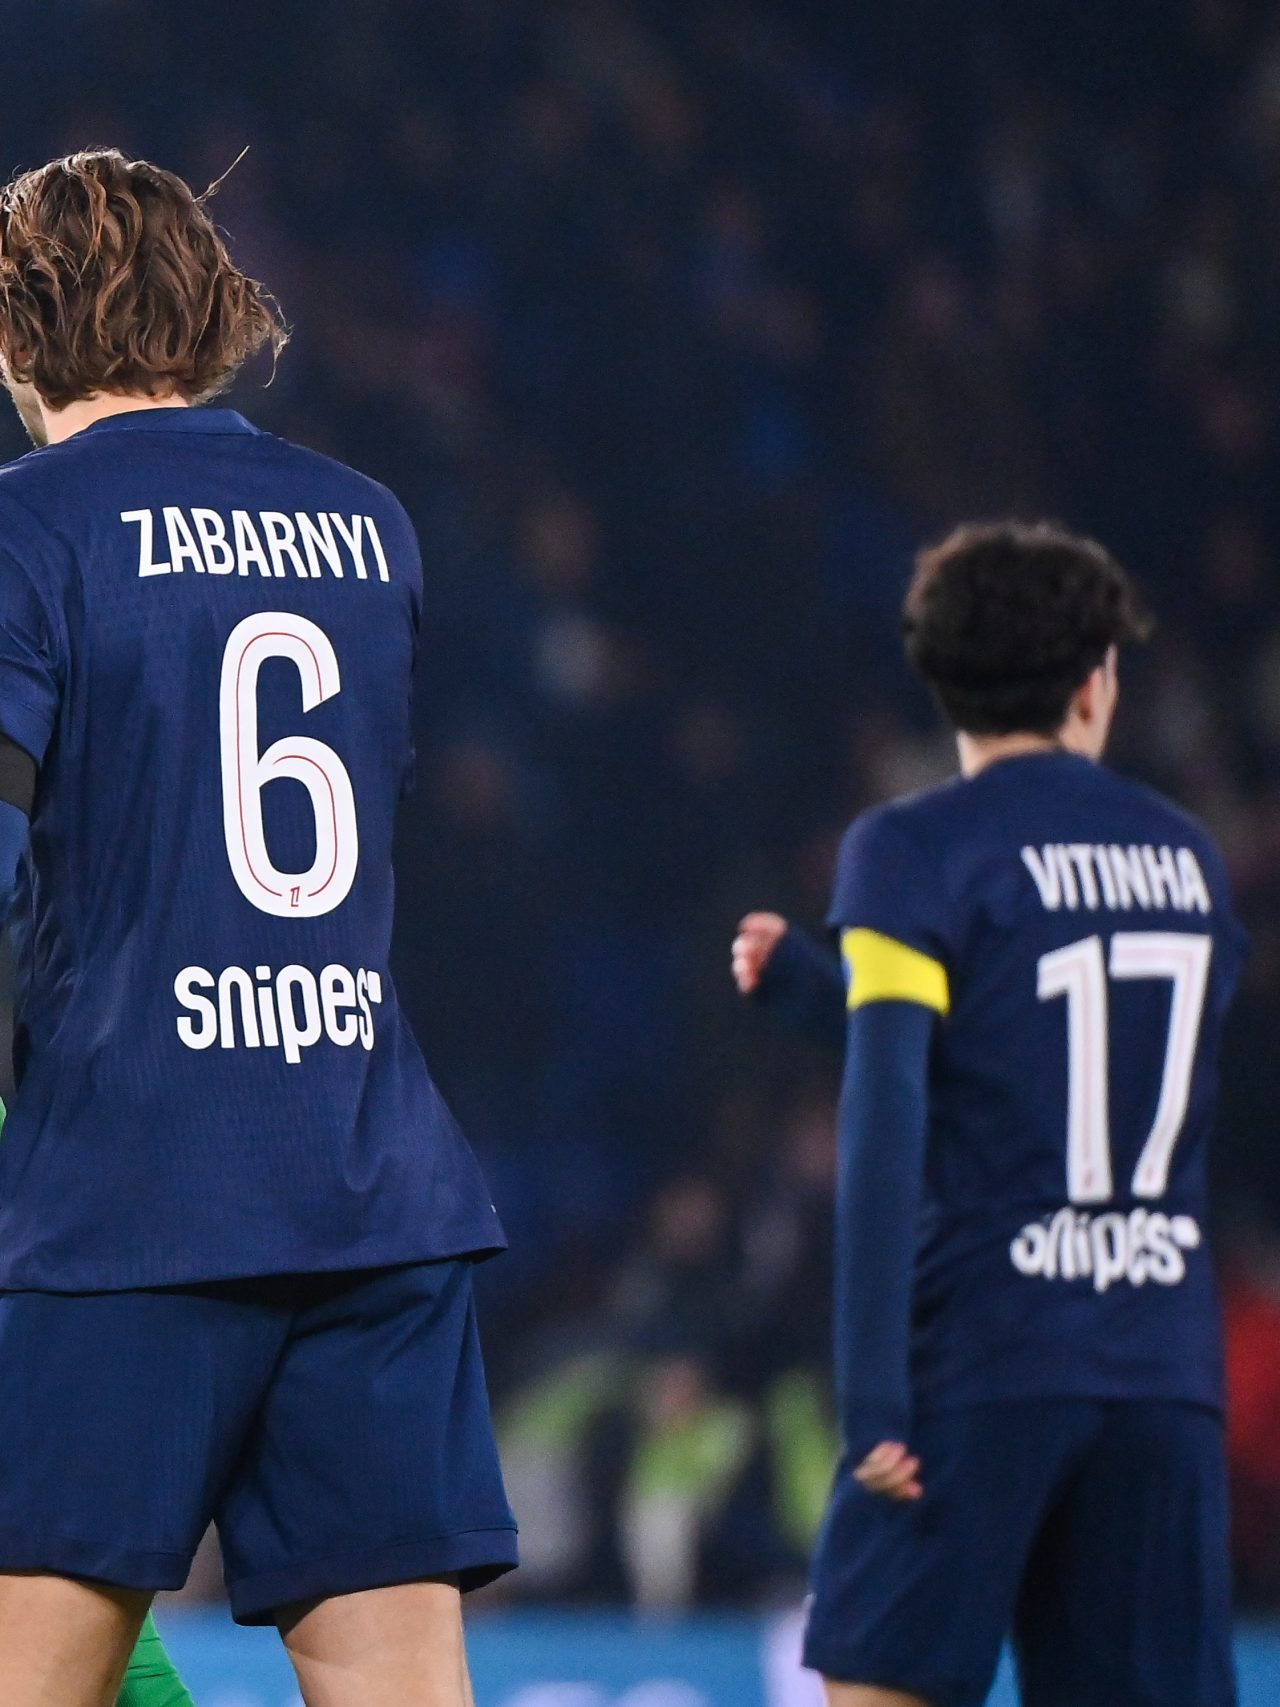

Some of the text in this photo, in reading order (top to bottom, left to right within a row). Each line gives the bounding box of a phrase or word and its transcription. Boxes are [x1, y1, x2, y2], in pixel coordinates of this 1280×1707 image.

[121, 506, 390, 583] ZABARNYI
[219, 611, 359, 918] 6
[1021, 843, 1212, 914] VITINHA
[173, 963, 382, 1064] snipes
[1036, 931, 1213, 1206] 17
